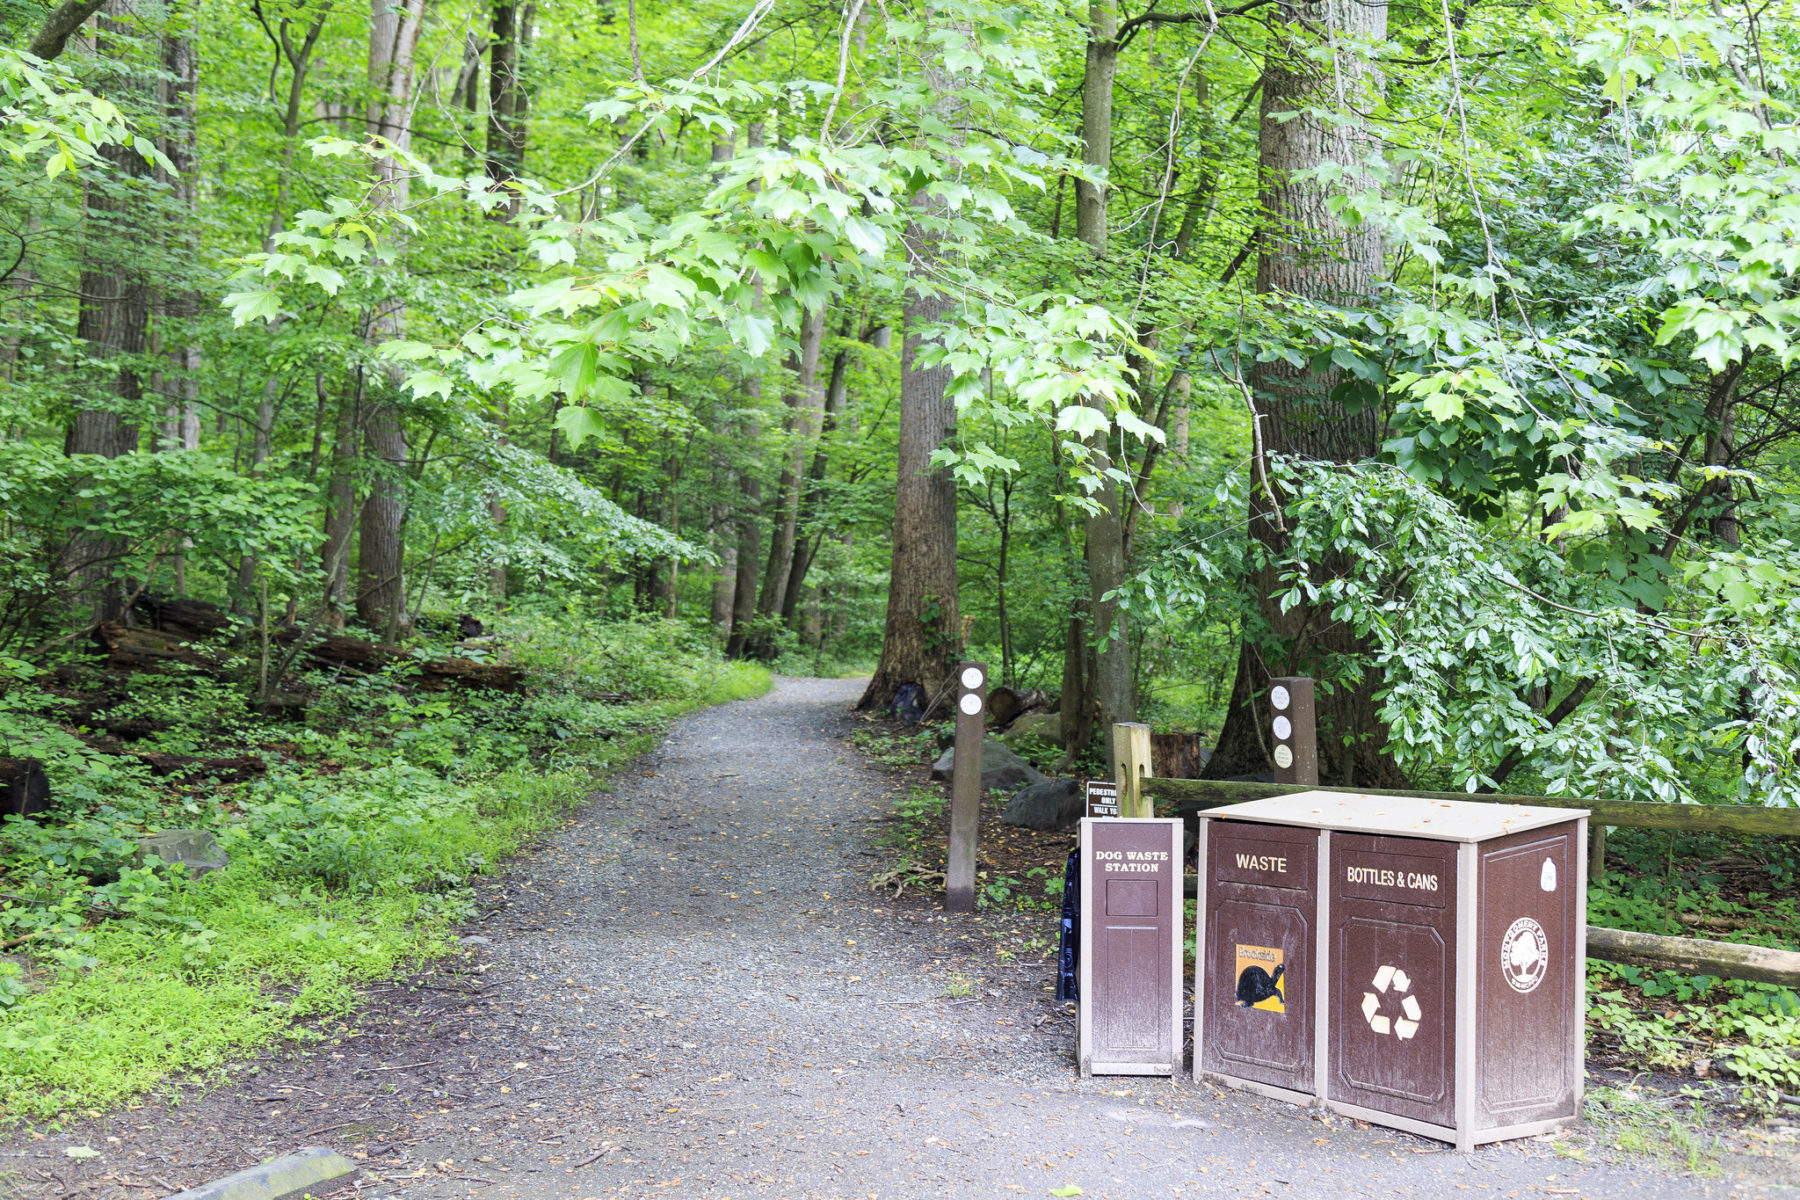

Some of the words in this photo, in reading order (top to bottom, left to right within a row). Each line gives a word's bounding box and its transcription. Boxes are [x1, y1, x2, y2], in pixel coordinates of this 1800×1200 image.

[1089, 788, 1117, 796] PEDESTRI
[1093, 806, 1109, 815] WALK
[1095, 851, 1122, 860] DOG
[1126, 851, 1168, 861] WASTE
[1105, 863, 1159, 872] STATION
[1236, 853, 1287, 873] WASTE
[1347, 866, 1395, 887] BOTTLES
[1397, 871, 1405, 888] &
[1407, 872, 1438, 892] CANS
